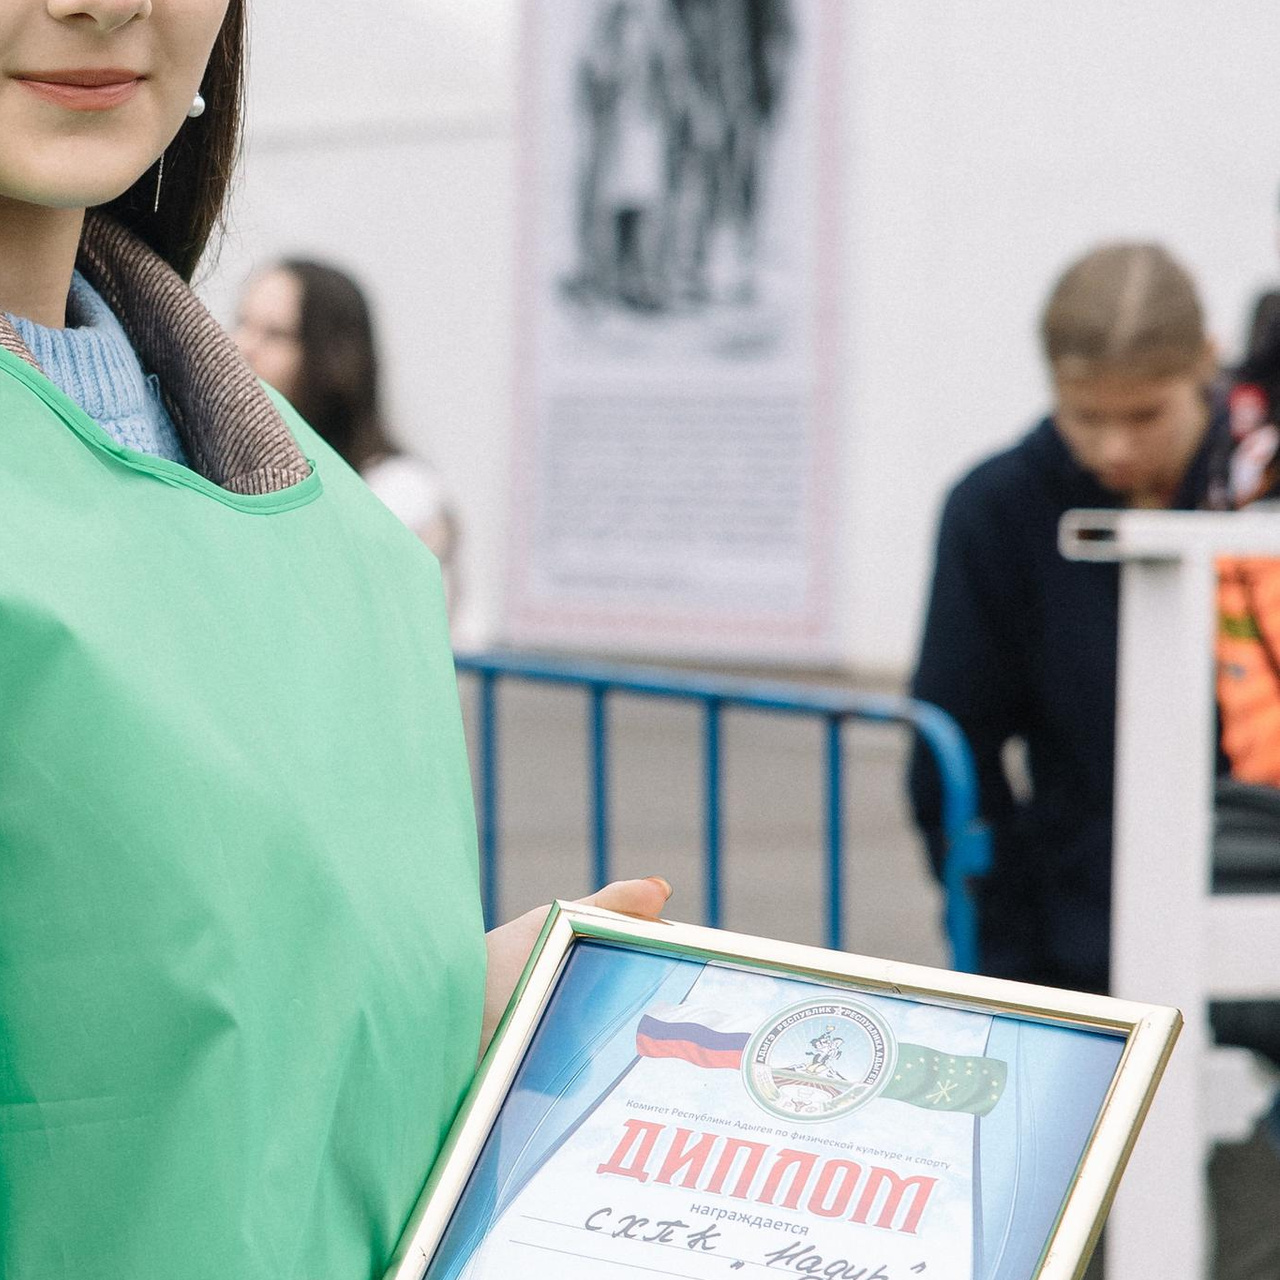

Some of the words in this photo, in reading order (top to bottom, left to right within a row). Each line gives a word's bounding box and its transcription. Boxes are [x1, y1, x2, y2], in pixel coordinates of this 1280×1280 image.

[777, 1006, 832, 1032] РЕСПУБЛИК
[626, 1099, 670, 1114] Комитет
[671, 1108, 732, 1126] Республики
[733, 1120, 772, 1134] Адыгея
[775, 1129, 788, 1137] по
[790, 1130, 854, 1150] физической
[856, 1145, 902, 1162] культуре
[905, 1154, 912, 1162] и
[914, 1156, 951, 1170] спорту
[596, 1119, 939, 1234] ДИПЛОМ
[689, 1203, 809, 1236] награждается
